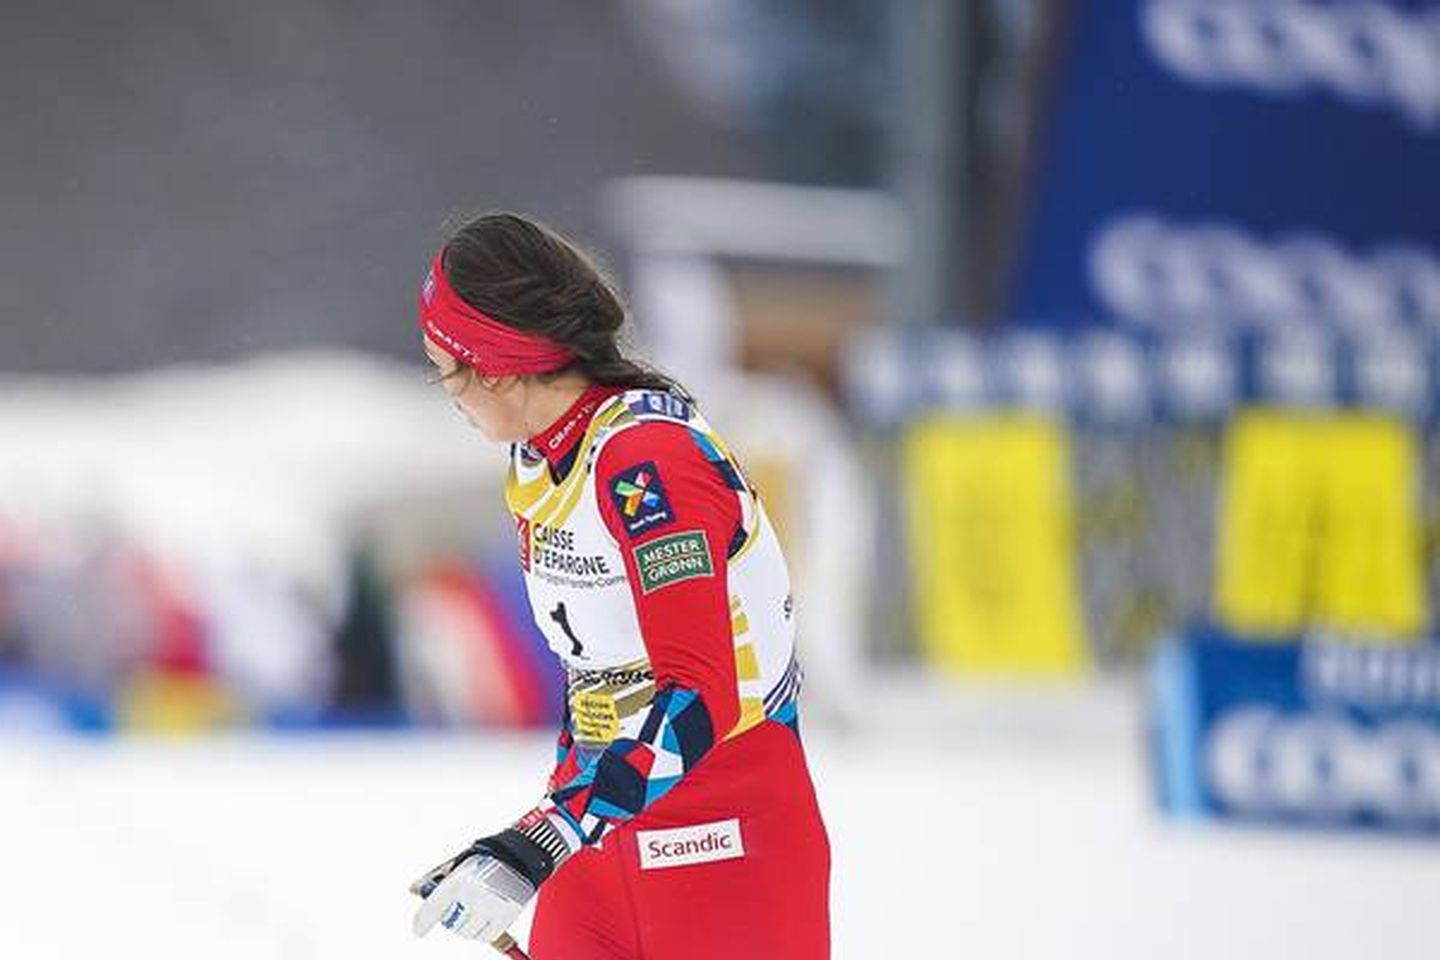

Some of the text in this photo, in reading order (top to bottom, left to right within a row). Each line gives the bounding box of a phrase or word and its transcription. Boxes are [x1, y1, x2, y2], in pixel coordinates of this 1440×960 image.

[533, 522, 574, 552] CAISSE
[643, 539, 703, 566] MESTER
[648, 556, 705, 582] GRØNN
[549, 601, 584, 657] 1
[647, 832, 733, 860] Scandic
